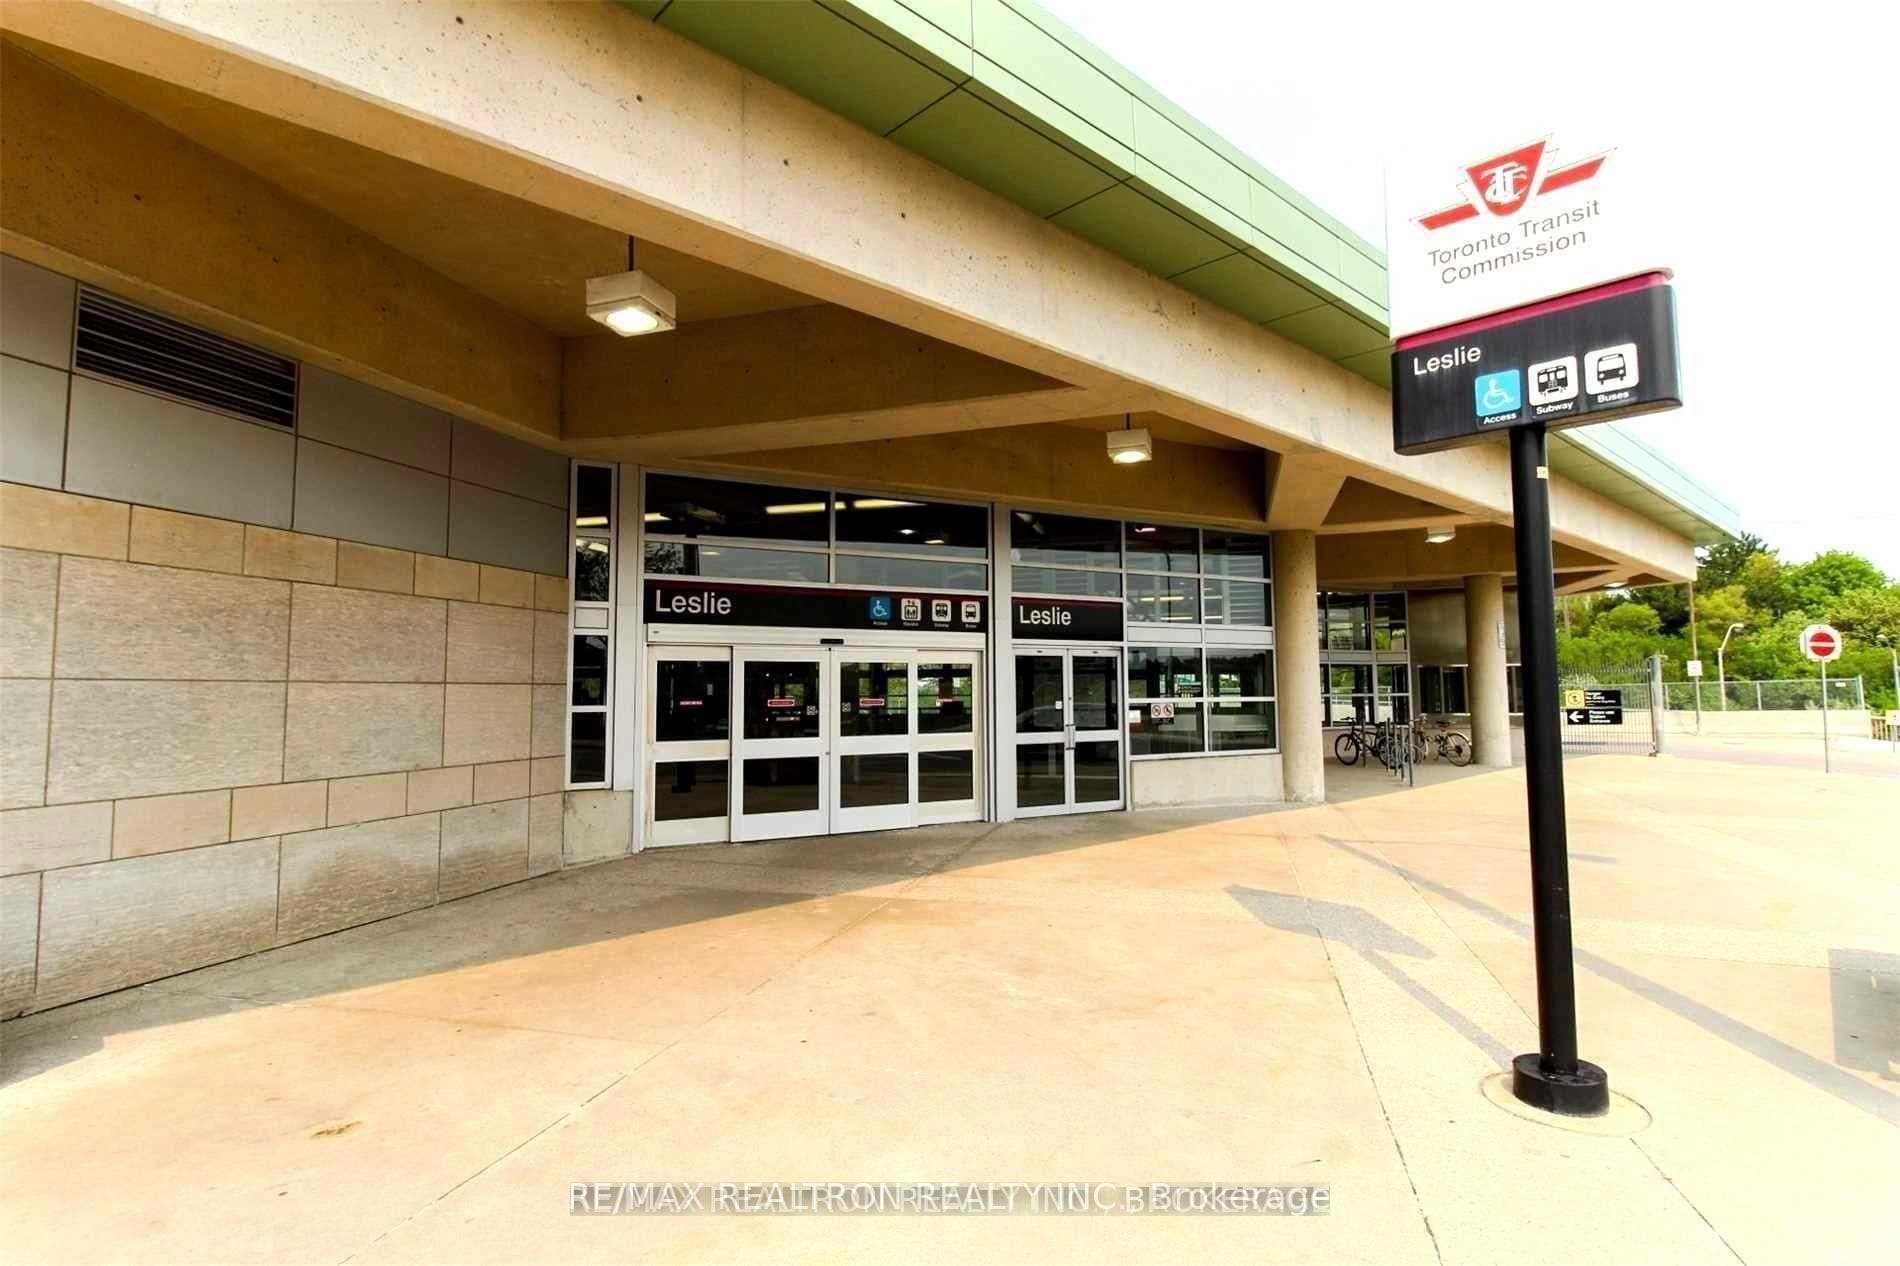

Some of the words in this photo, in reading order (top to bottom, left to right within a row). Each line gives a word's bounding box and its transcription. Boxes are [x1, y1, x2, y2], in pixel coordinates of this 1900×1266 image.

[1428, 230, 1511, 267] Toronto
[1518, 200, 1601, 240] Transit
[1441, 230, 1587, 285] Commission
[1413, 345, 1481, 376] Leslie
[1535, 400, 1574, 416] Subway
[1597, 390, 1630, 403] Buses
[1483, 411, 1518, 425] Access
[655, 589, 732, 615] Leslie
[1020, 605, 1072, 625] Leslie
